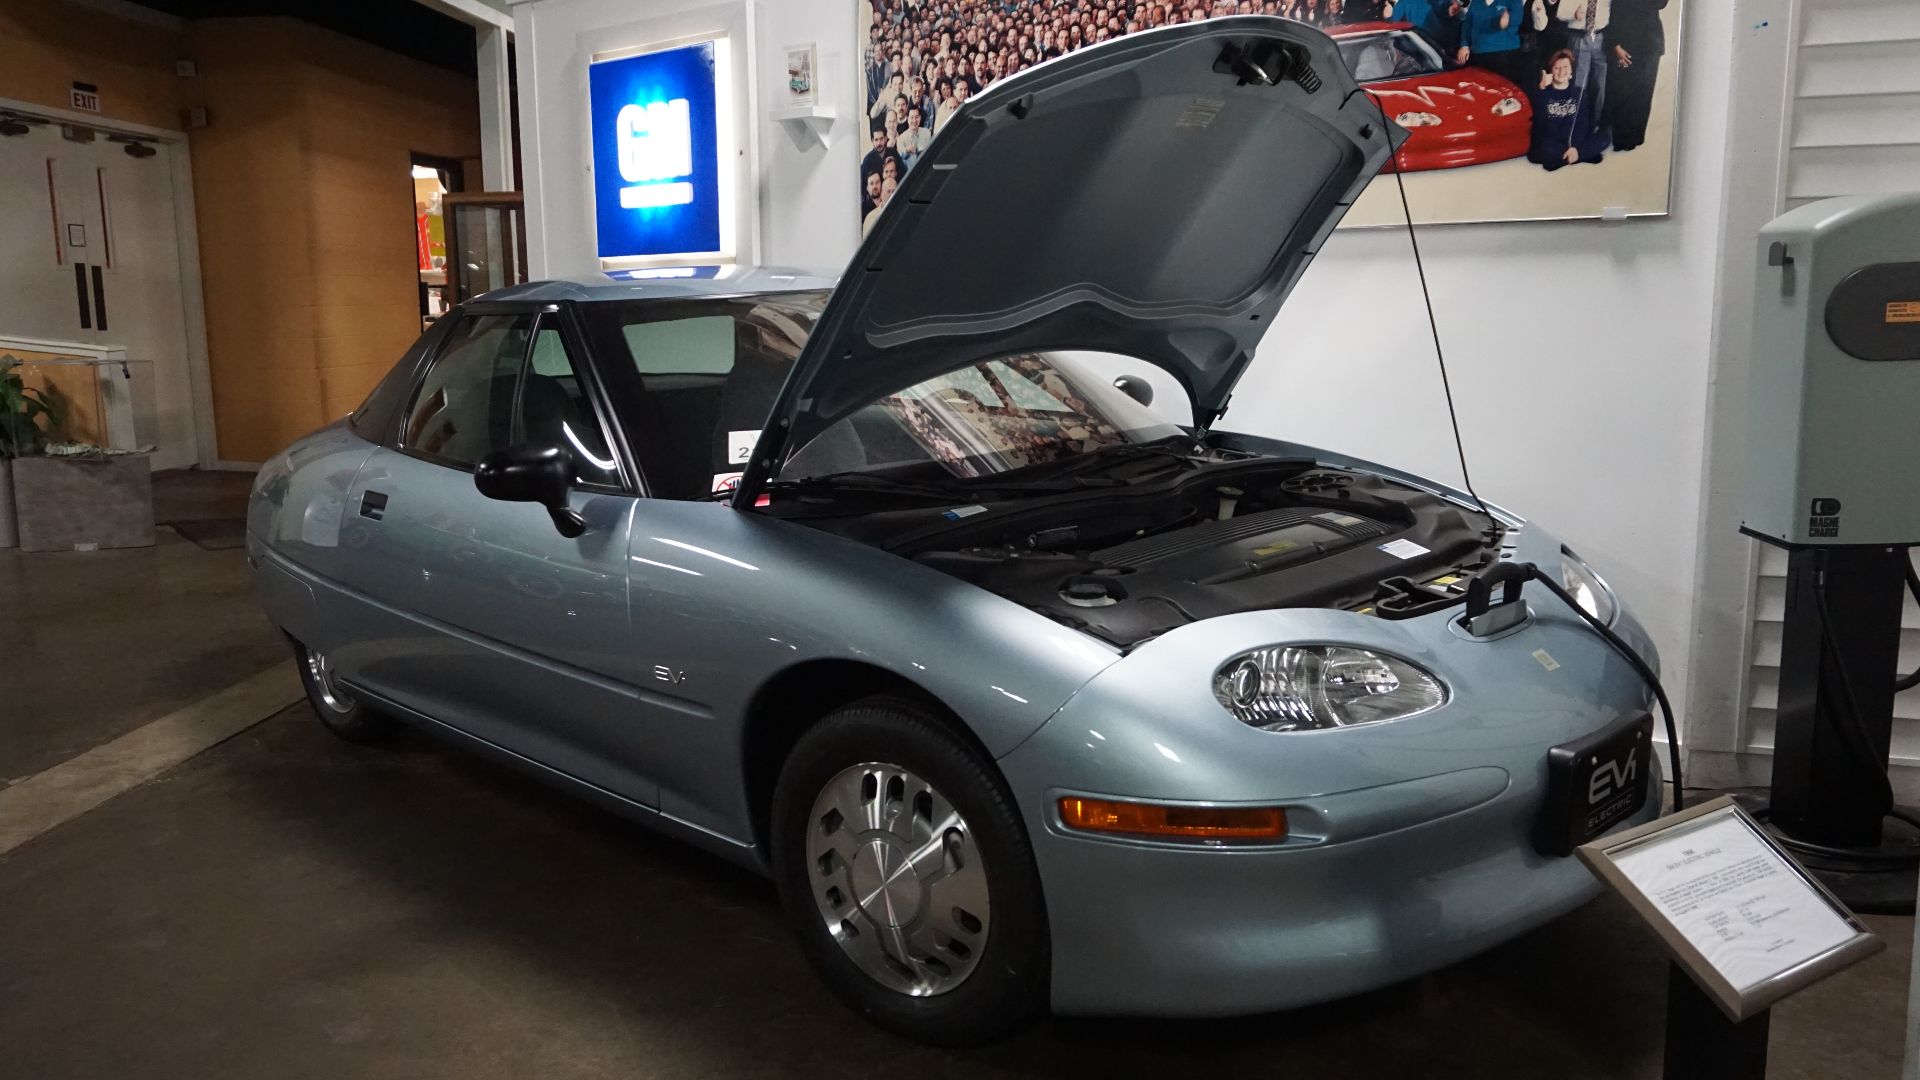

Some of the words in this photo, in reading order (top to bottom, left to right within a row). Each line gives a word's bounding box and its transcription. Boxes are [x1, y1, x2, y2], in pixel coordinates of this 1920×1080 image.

[73, 92, 97, 110] EXIT
[616, 98, 693, 183] GM
[1588, 747, 1636, 804] EV1
[1588, 794, 1632, 828] ELECTRIC
